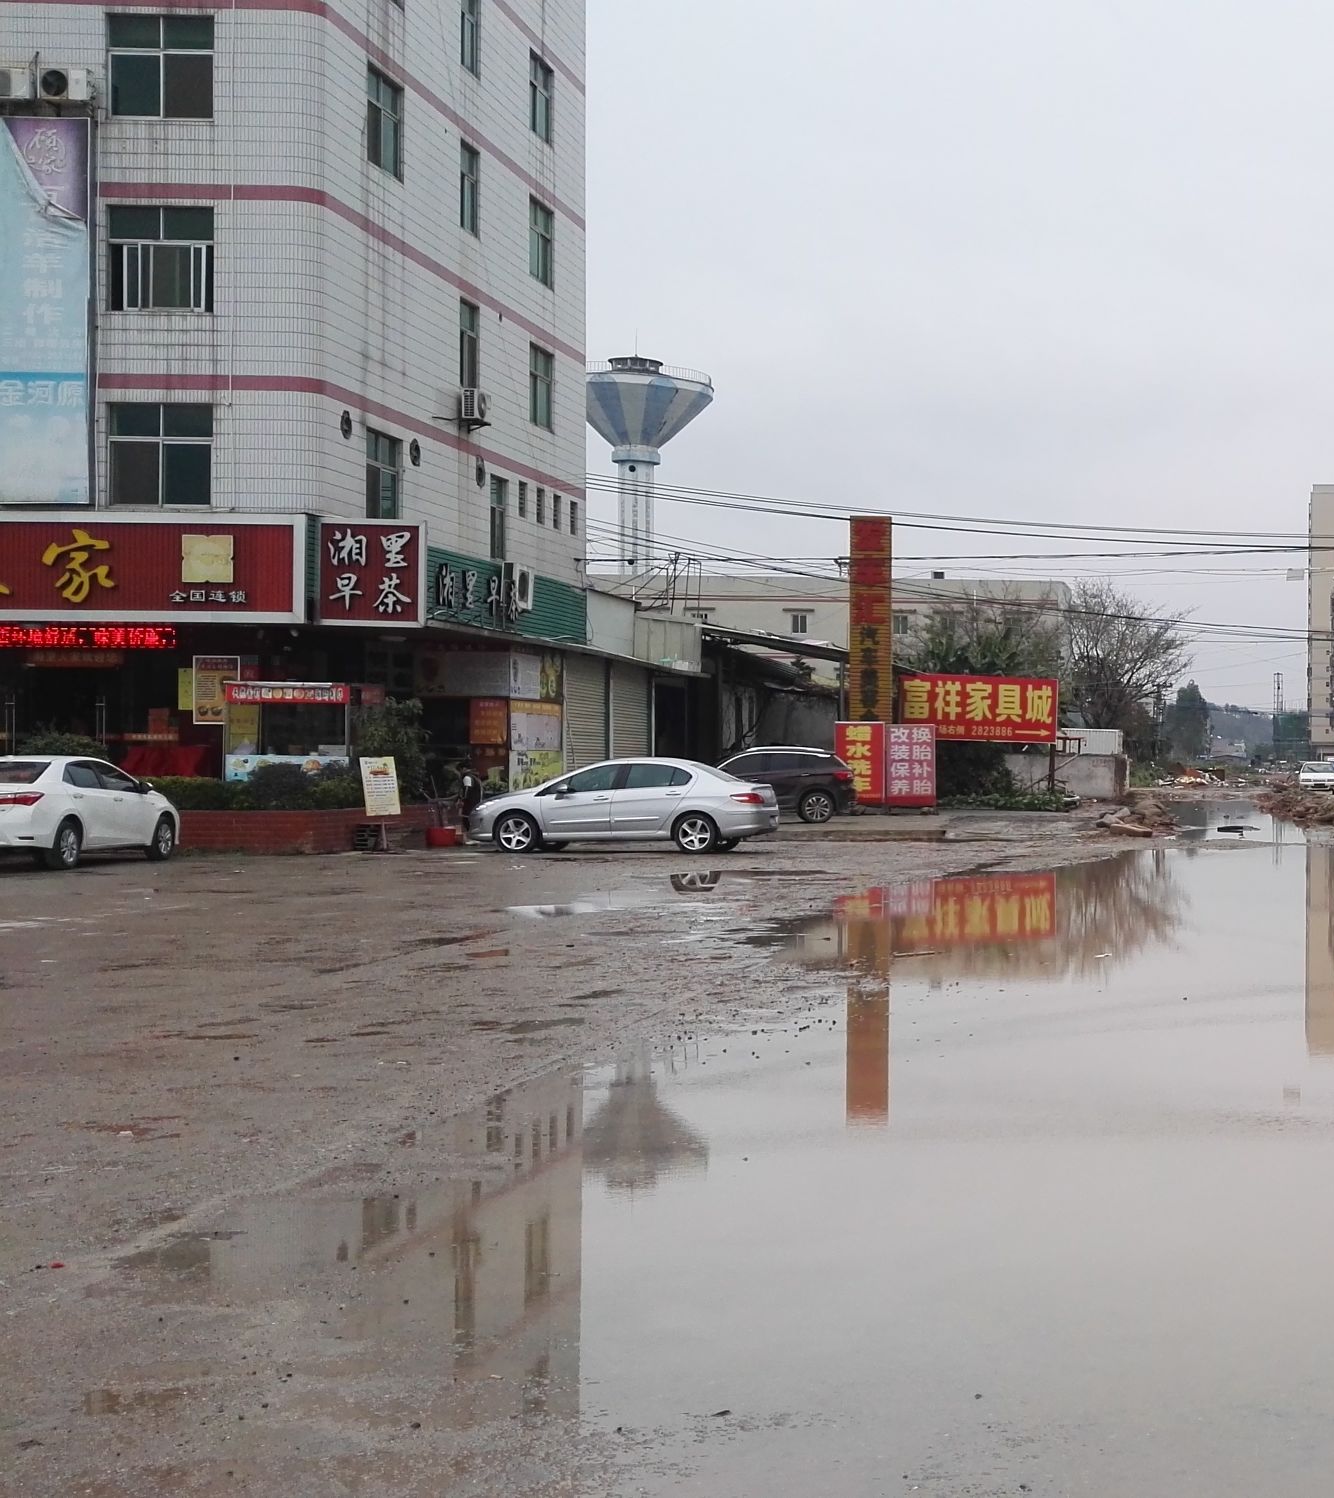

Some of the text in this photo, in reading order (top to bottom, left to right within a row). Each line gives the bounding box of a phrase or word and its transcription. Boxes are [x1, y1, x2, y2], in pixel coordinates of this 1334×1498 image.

[328, 529, 412, 568] 湘里
[169, 589, 247, 604] 全国连锁
[328, 573, 412, 614] 早茶
[903, 680, 1053, 724] 富祥家具城
[935, 725, 966, 736] 场右侧
[845, 725, 872, 792] 蜡水洗车
[890, 727, 910, 796] 改装保养
[911, 727, 932, 796] 换胎补胎
